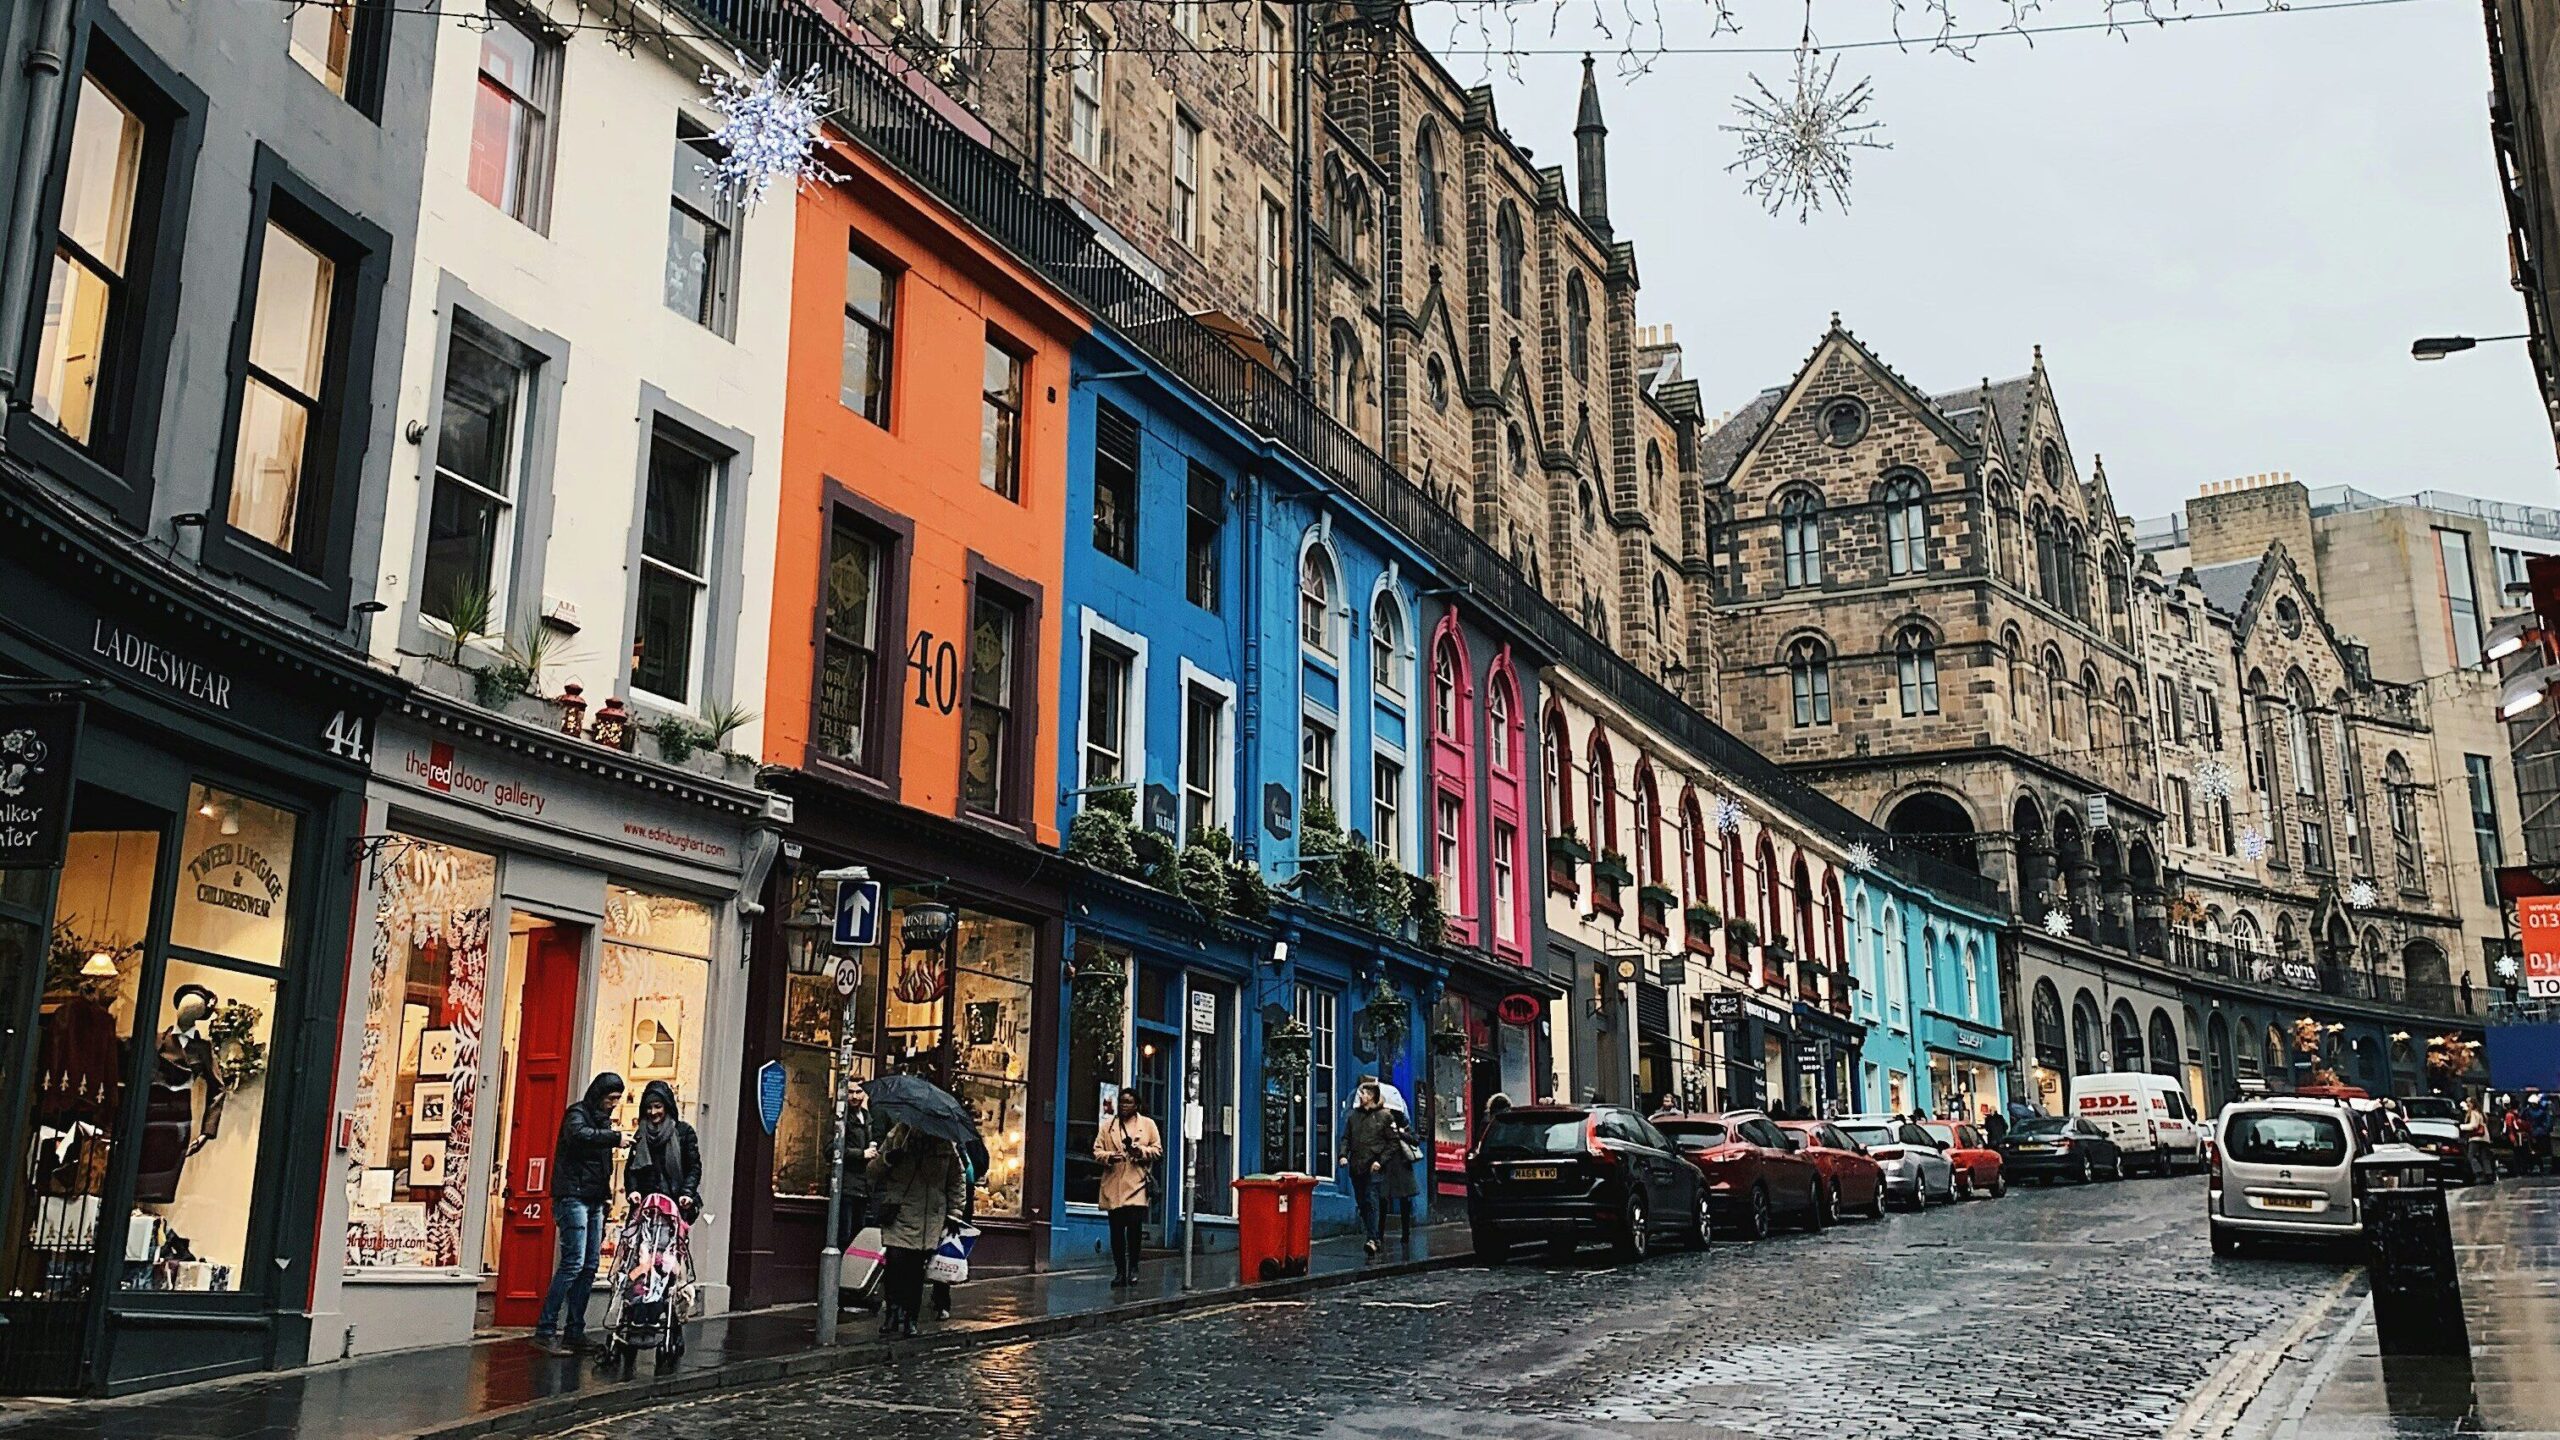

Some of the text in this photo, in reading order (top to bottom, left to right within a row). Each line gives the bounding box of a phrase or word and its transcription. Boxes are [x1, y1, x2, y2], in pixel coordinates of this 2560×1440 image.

[93, 618, 231, 709] LADIESWEAR
[906, 630, 957, 715] 40
[323, 710, 371, 763] 44.
[406, 749, 546, 815] the red door gallery
[0, 826, 39, 847] ter
[623, 822, 726, 857] www.edinburghart.com
[188, 842, 283, 904] TWEED LUGGAGE
[197, 883, 270, 918] CHILDRENSWEAR
[838, 968, 855, 986] 20
[2533, 980, 2560, 994] TO
[2079, 1094, 2137, 1109] BDL
[2080, 1109, 2138, 1118] DEMOLITION
[522, 1203, 541, 1220] 42
